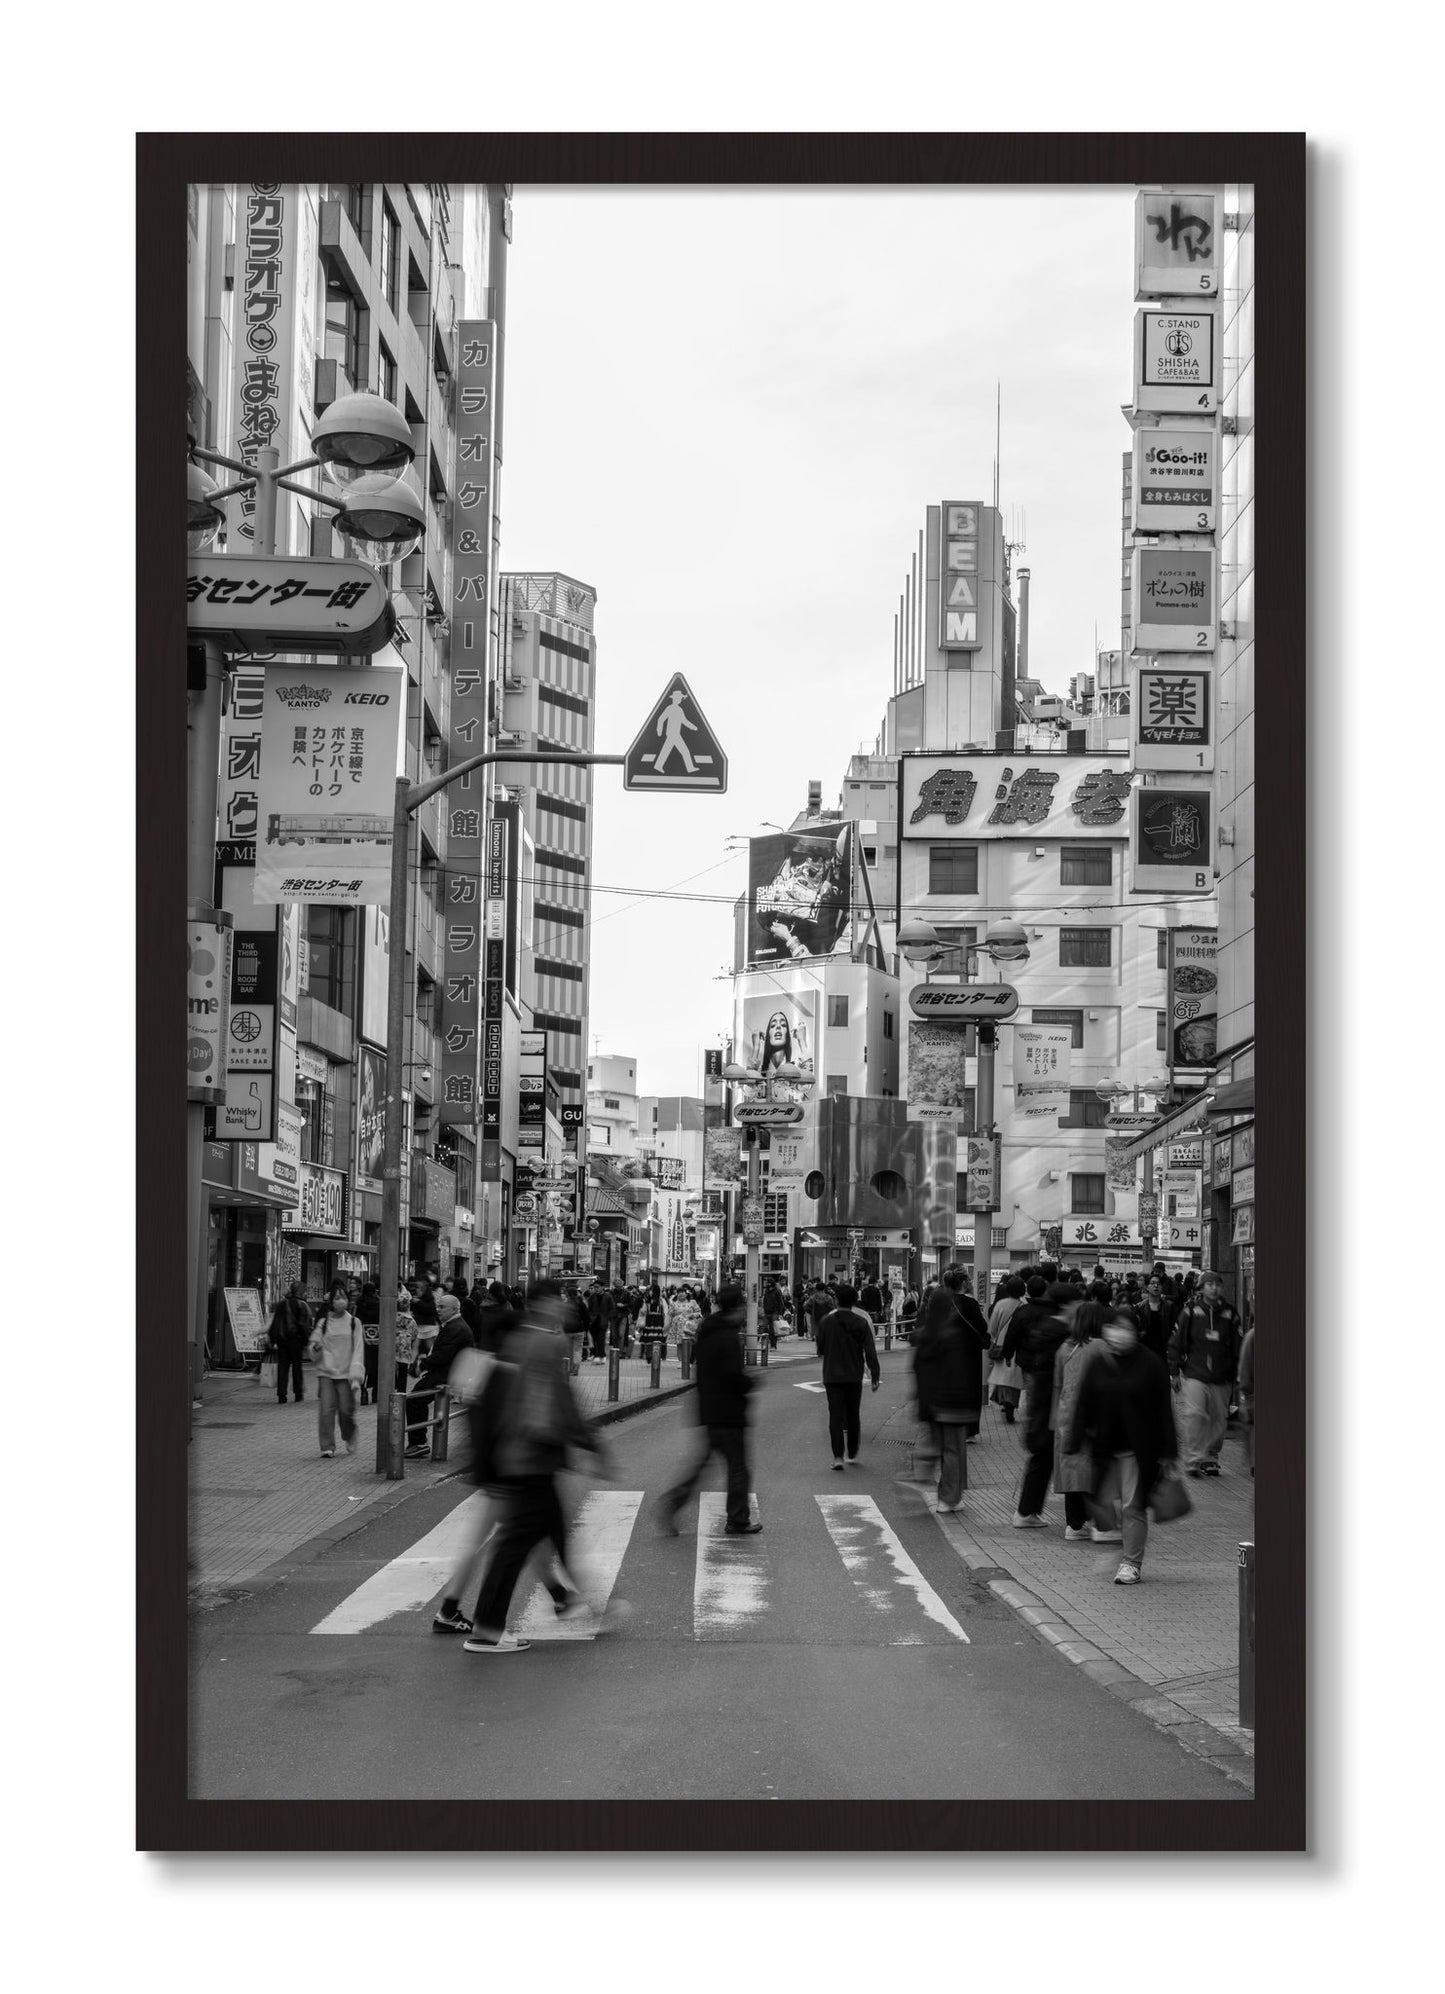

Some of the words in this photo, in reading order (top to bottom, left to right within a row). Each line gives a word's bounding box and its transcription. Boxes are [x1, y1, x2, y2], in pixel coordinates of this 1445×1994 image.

[245, 196, 284, 325] カラオケ
[1200, 275, 1211, 290] 5
[1158, 319, 1200, 329] C.STAND
[1157, 357, 1200, 368] SHISHA
[1157, 368, 1200, 376] CAFE&BAR
[1197, 393, 1210, 408] 4
[1156, 449, 1207, 465] Goo-it!
[1145, 491, 1208, 502] 全身もみほぐし
[1197, 512, 1208, 528] 3
[946, 506, 977, 642] BEAM
[1196, 631, 1208, 647] 2
[288, 700, 321, 708] KANTO
[344, 692, 391, 706] KEIO
[1149, 677, 1196, 725] 薬
[1143, 728, 1202, 742] マツモトキヨシ
[292, 726, 308, 766] 冒険へ
[309, 726, 326, 796] カントーの
[349, 727, 365, 783] 京王線で
[1196, 752, 1204, 767] 1
[910, 767, 1135, 825] 角海老
[1143, 804, 1201, 850] 一蘭
[493, 823, 502, 857] kimono
[280, 879, 363, 892] 渋谷センター街
[1195, 872, 1206, 888] B
[237, 949, 259, 957] THIRD
[241, 942, 256, 950] THE
[915, 992, 1013, 1005] 渋谷センター街
[1174, 1001, 1202, 1020] 6F
[225, 1116, 244, 1124] Bank
[226, 1107, 258, 1118] Whisky
[563, 1110, 582, 1120] GU
